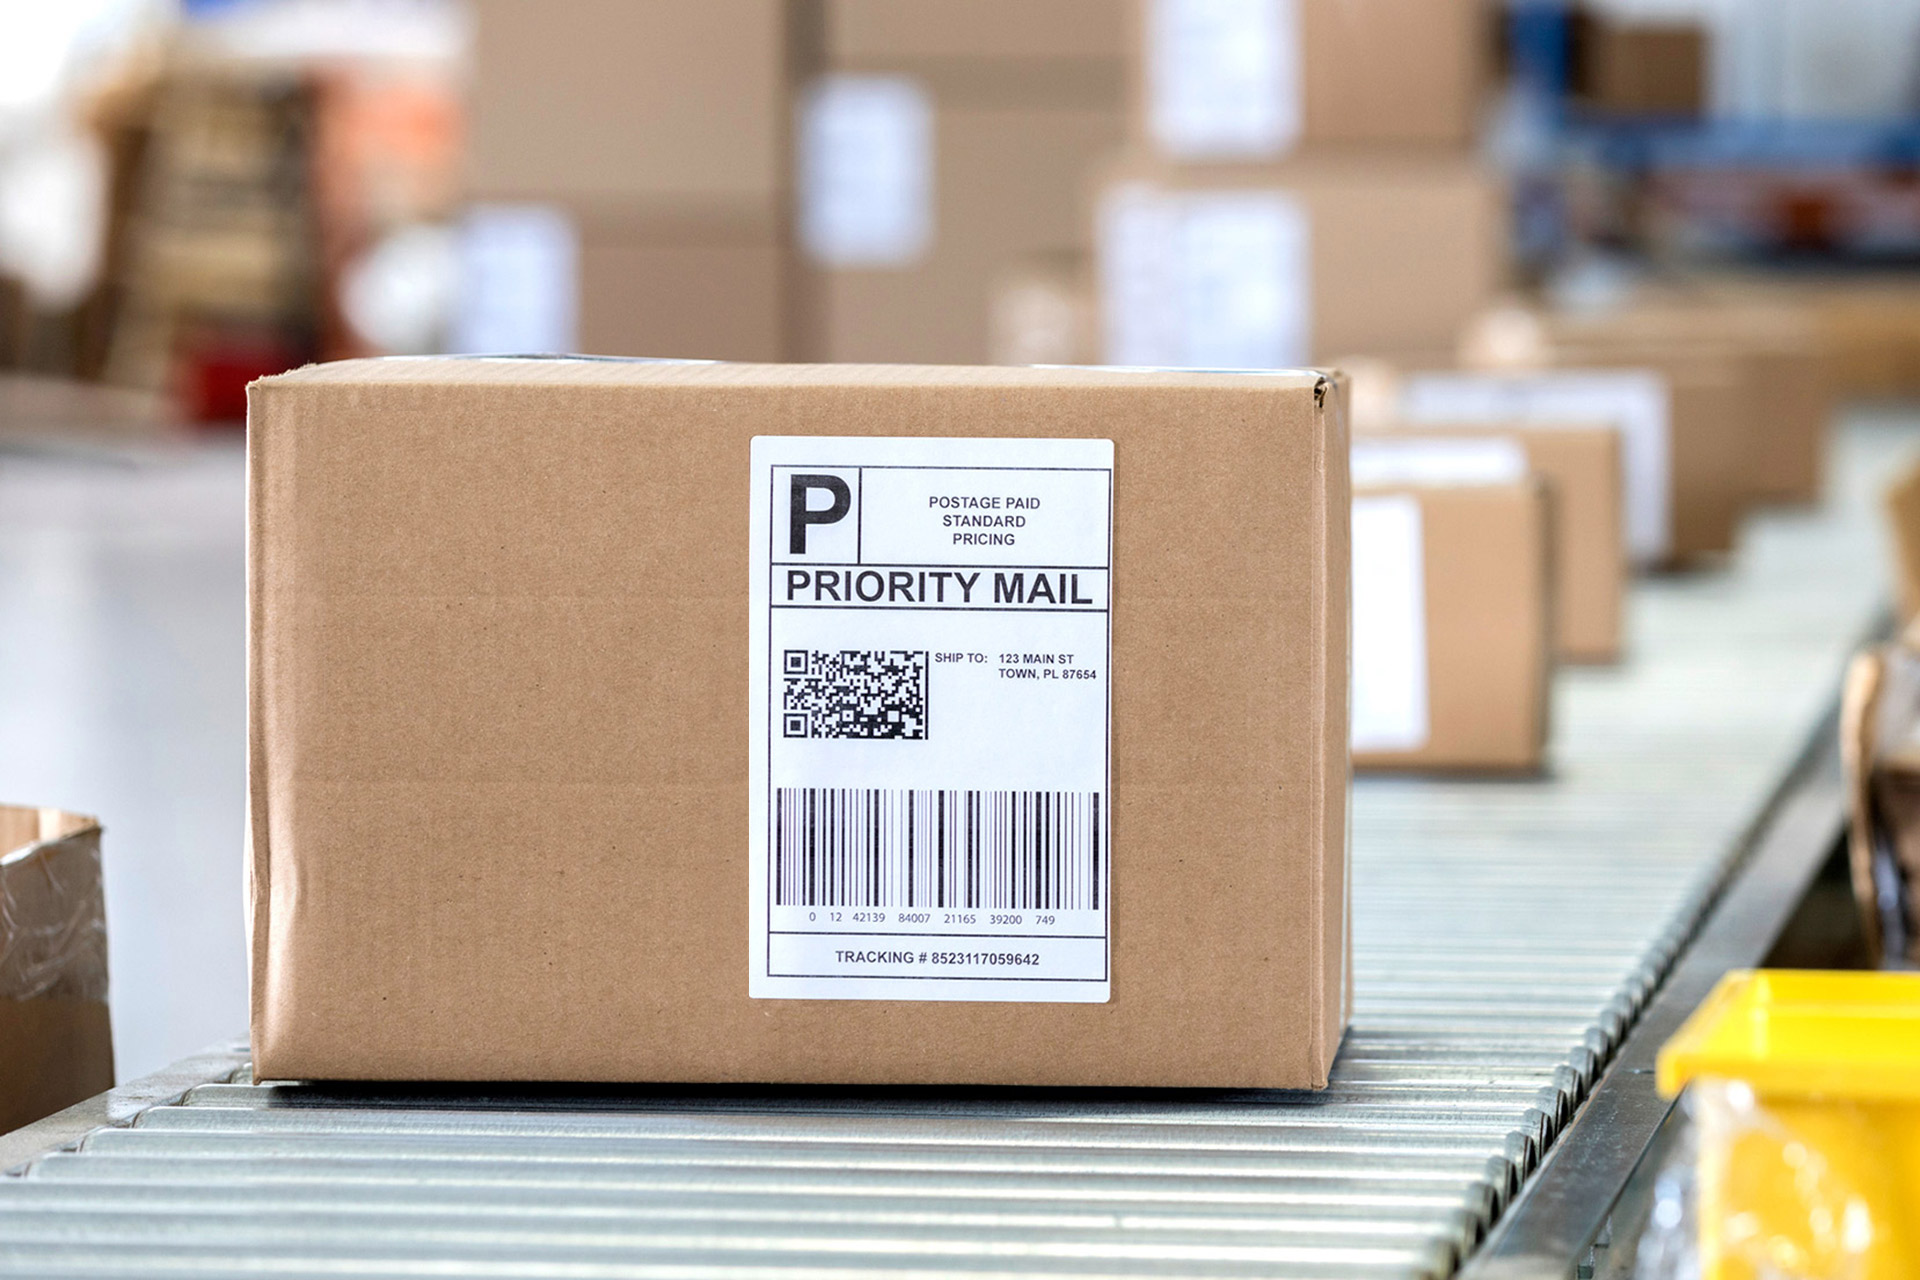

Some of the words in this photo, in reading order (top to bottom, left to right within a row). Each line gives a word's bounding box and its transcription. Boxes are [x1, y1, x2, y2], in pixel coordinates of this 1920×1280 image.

[930, 497, 1000, 509] POSTAGE
[1007, 498, 1040, 510] PAID
[790, 474, 851, 554] P
[943, 515, 1025, 528] STANDARD
[954, 534, 1014, 546] PRICING
[788, 570, 980, 602] PRIORITY
[995, 573, 1092, 604] MAIL
[935, 653, 963, 663] SHIP
[967, 653, 987, 664] TO:
[1000, 654, 1019, 664] 123
[1024, 654, 1054, 664] MAIN
[1059, 654, 1074, 665] ST
[999, 669, 1039, 681] TOWN,
[1044, 669, 1058, 680] PL
[1063, 670, 1096, 680] 87654
[809, 912, 816, 922] 0
[831, 912, 842, 922] 12
[853, 913, 885, 923] 42139
[899, 913, 930, 924] 84007
[945, 914, 976, 925] 21165
[991, 915, 1022, 925] 39200
[1036, 916, 1055, 926] 749
[836, 951, 913, 964] TRACKING
[919, 953, 927, 964] #
[932, 953, 1039, 966] 8523117059642
